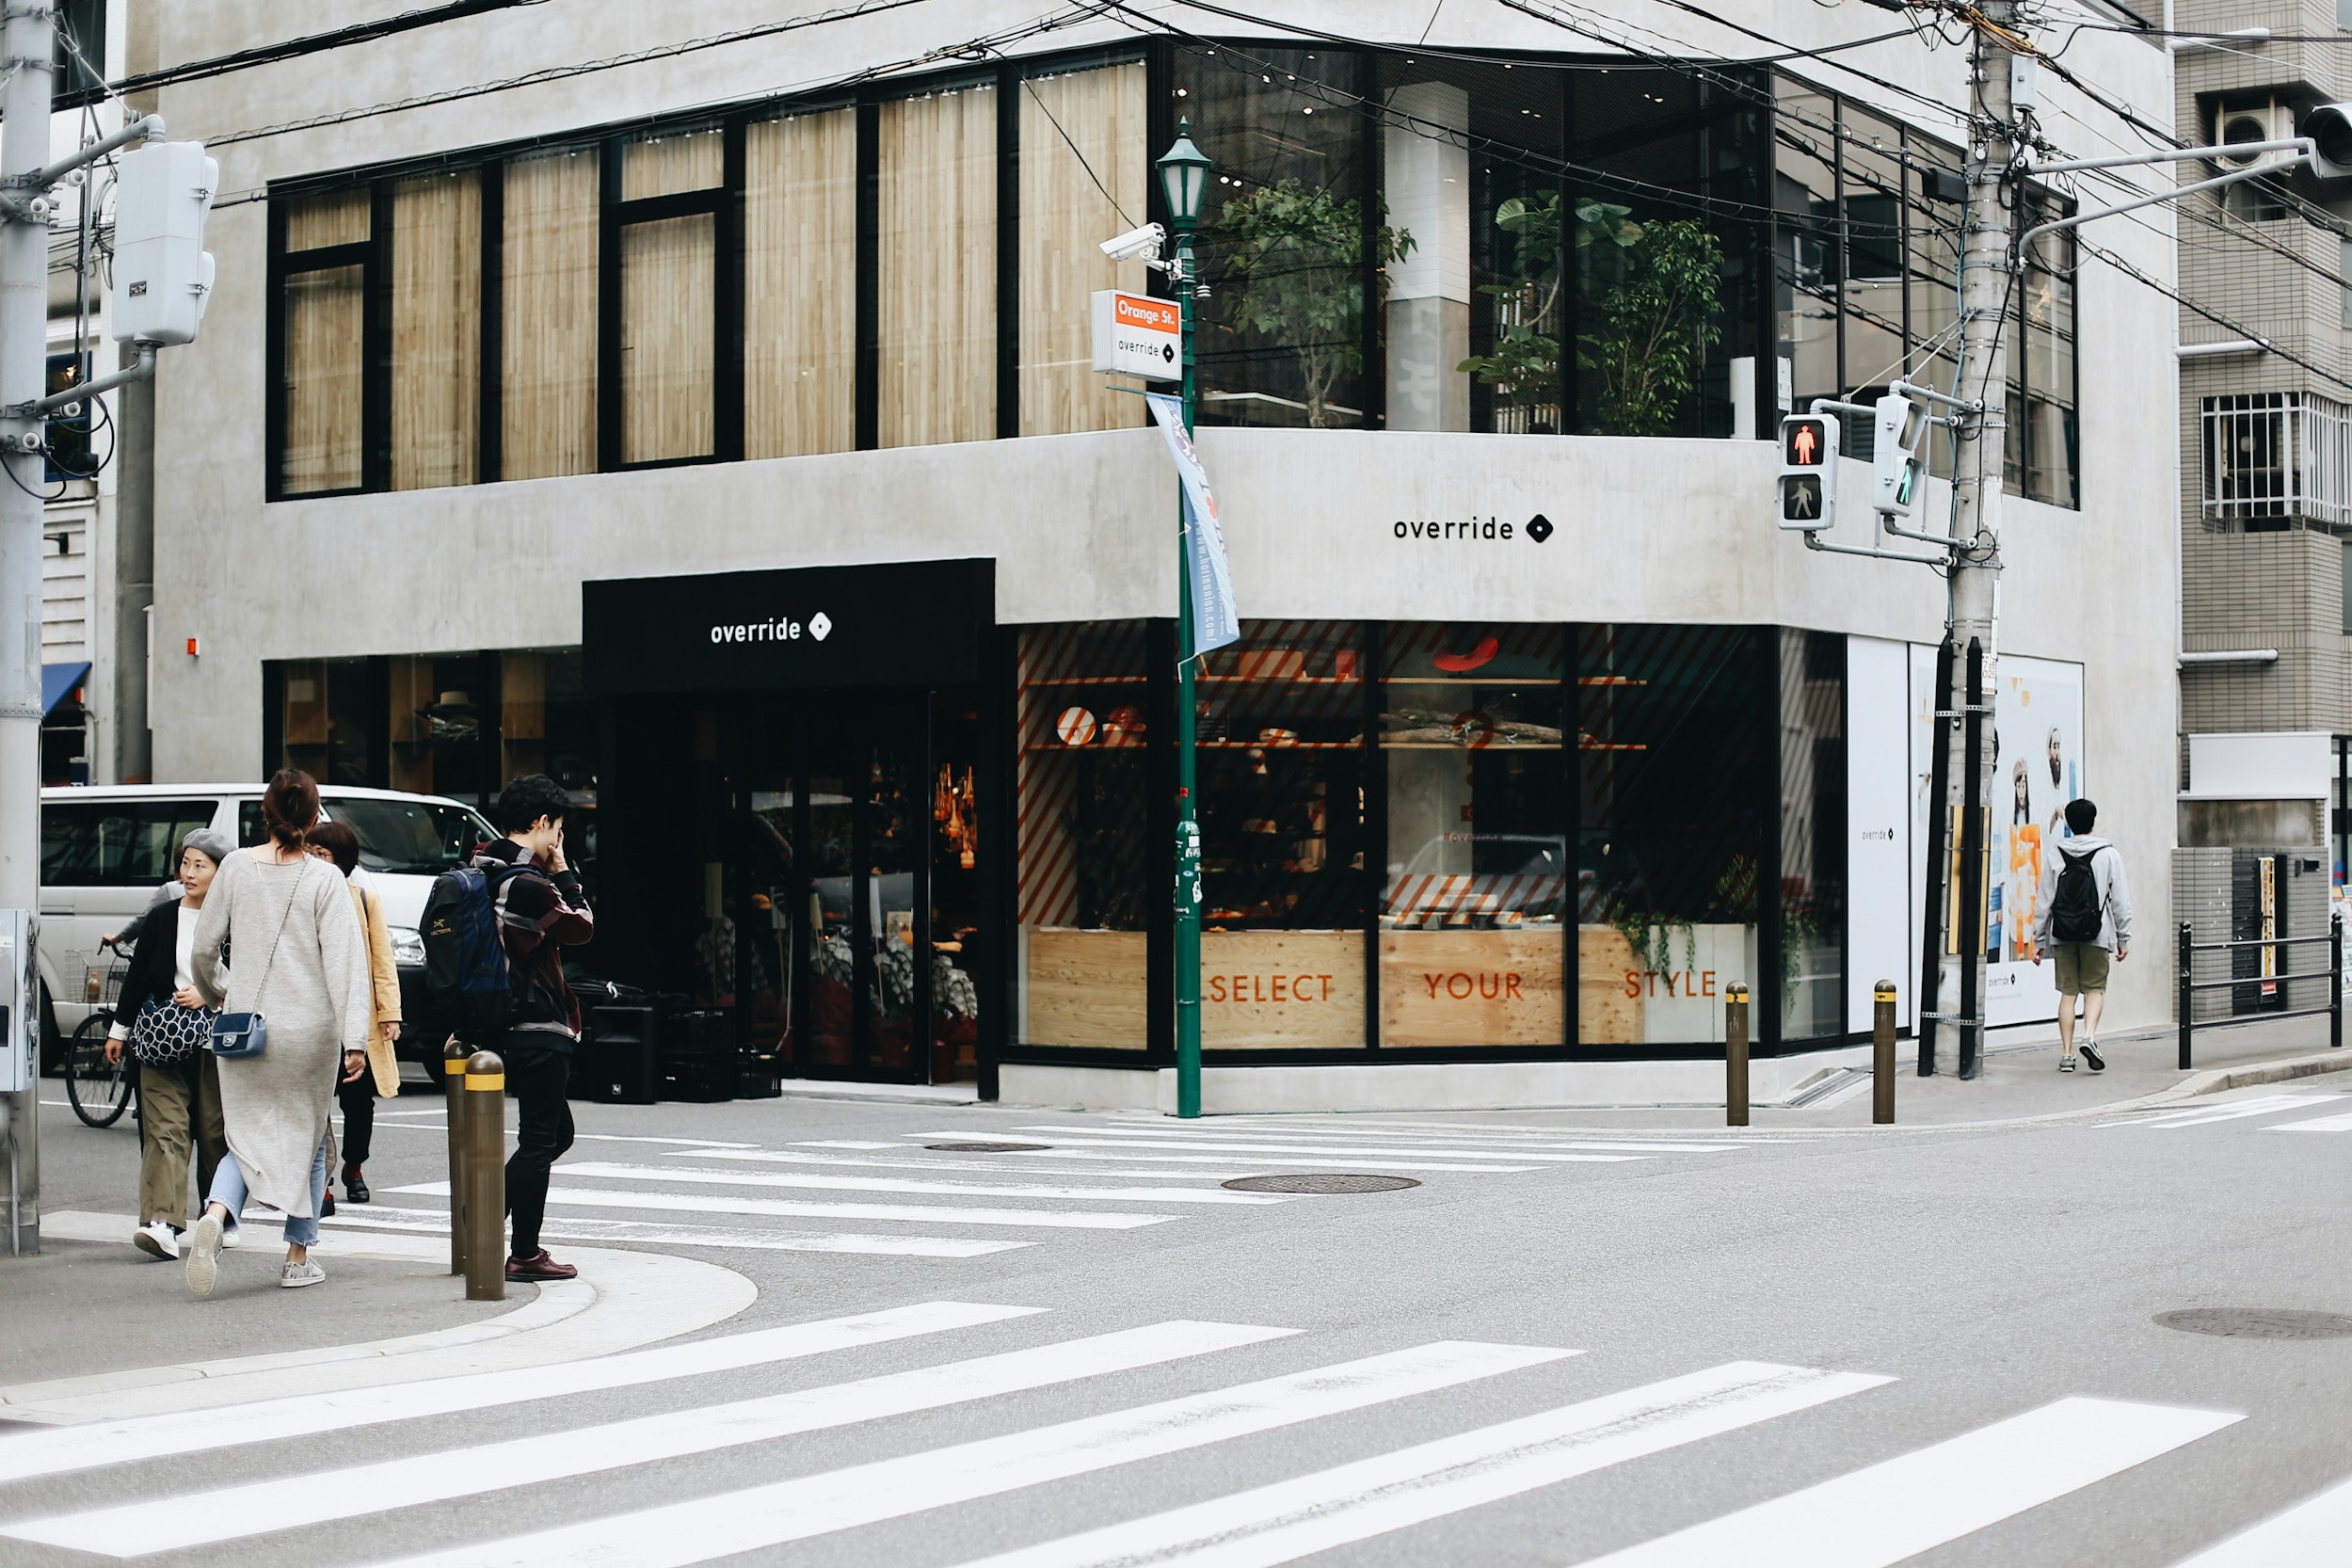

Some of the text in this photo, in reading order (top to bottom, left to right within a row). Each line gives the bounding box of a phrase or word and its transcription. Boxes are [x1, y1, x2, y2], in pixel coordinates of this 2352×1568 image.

[1118, 298, 1176, 326] Orange St.
[1118, 340, 1159, 357] override
[1394, 516, 1513, 539] override
[711, 616, 801, 644] override
[1209, 970, 1717, 1002] SELECT YOUR STYLE
